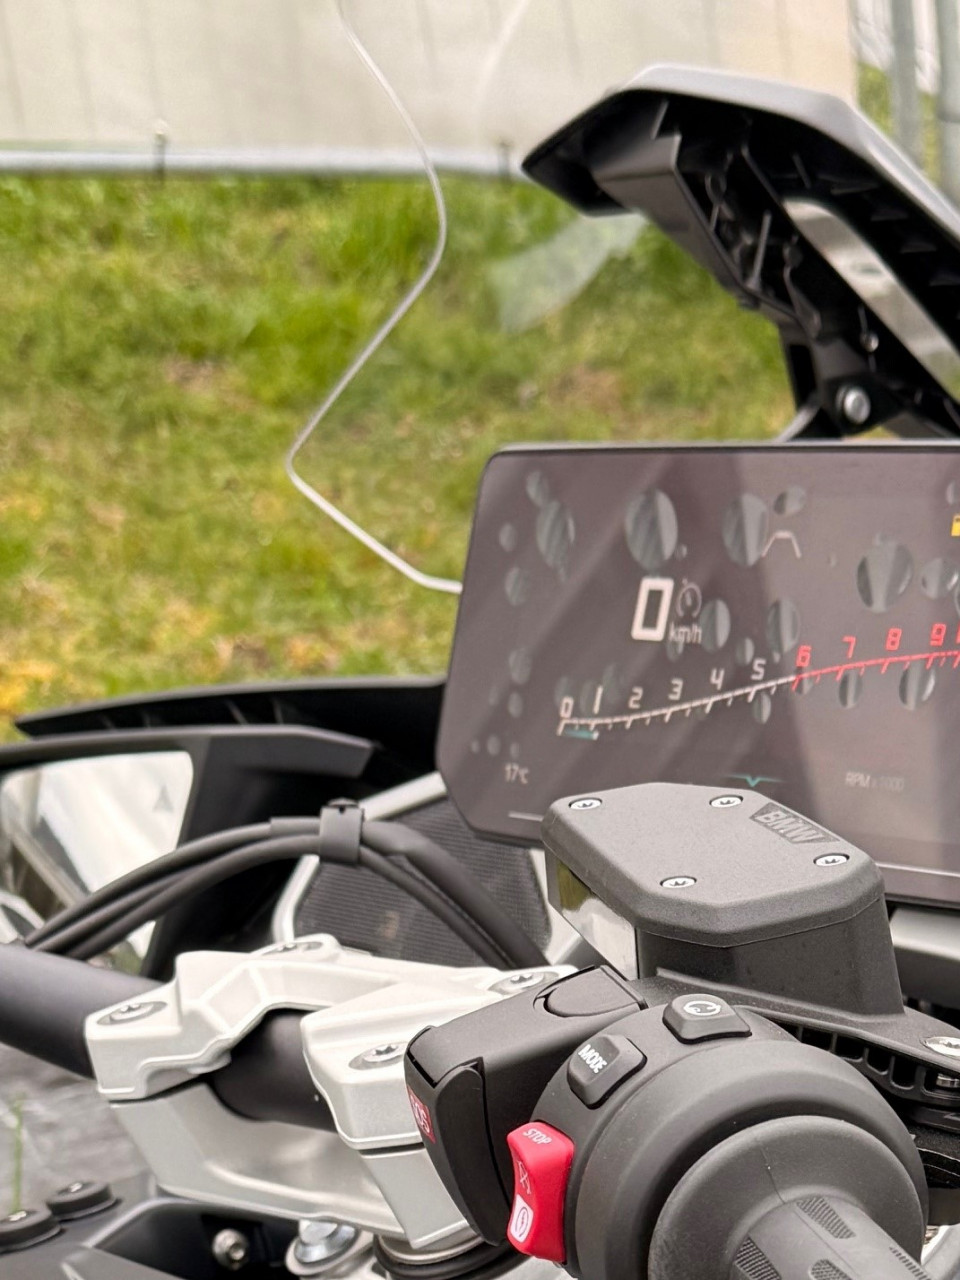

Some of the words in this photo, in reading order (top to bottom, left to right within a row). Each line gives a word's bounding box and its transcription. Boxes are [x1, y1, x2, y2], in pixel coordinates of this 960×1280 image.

[631, 577, 675, 642] 0
[668, 622, 702, 645] km/h
[560, 697, 575, 718] 0
[593, 685, 604, 714] 1
[628, 686, 643, 709] 2
[668, 678, 683, 701] 3
[710, 667, 725, 690] 4
[751, 658, 767, 680] 5
[796, 644, 812, 667] 6
[842, 637, 855, 658] 7
[885, 628, 902, 651] 8
[930, 623, 947, 646] 9
[845, 771, 871, 788] RPM
[755, 811, 825, 843] BMW
[578, 1044, 608, 1074] MODE
[522, 1128, 553, 1145] STOP
